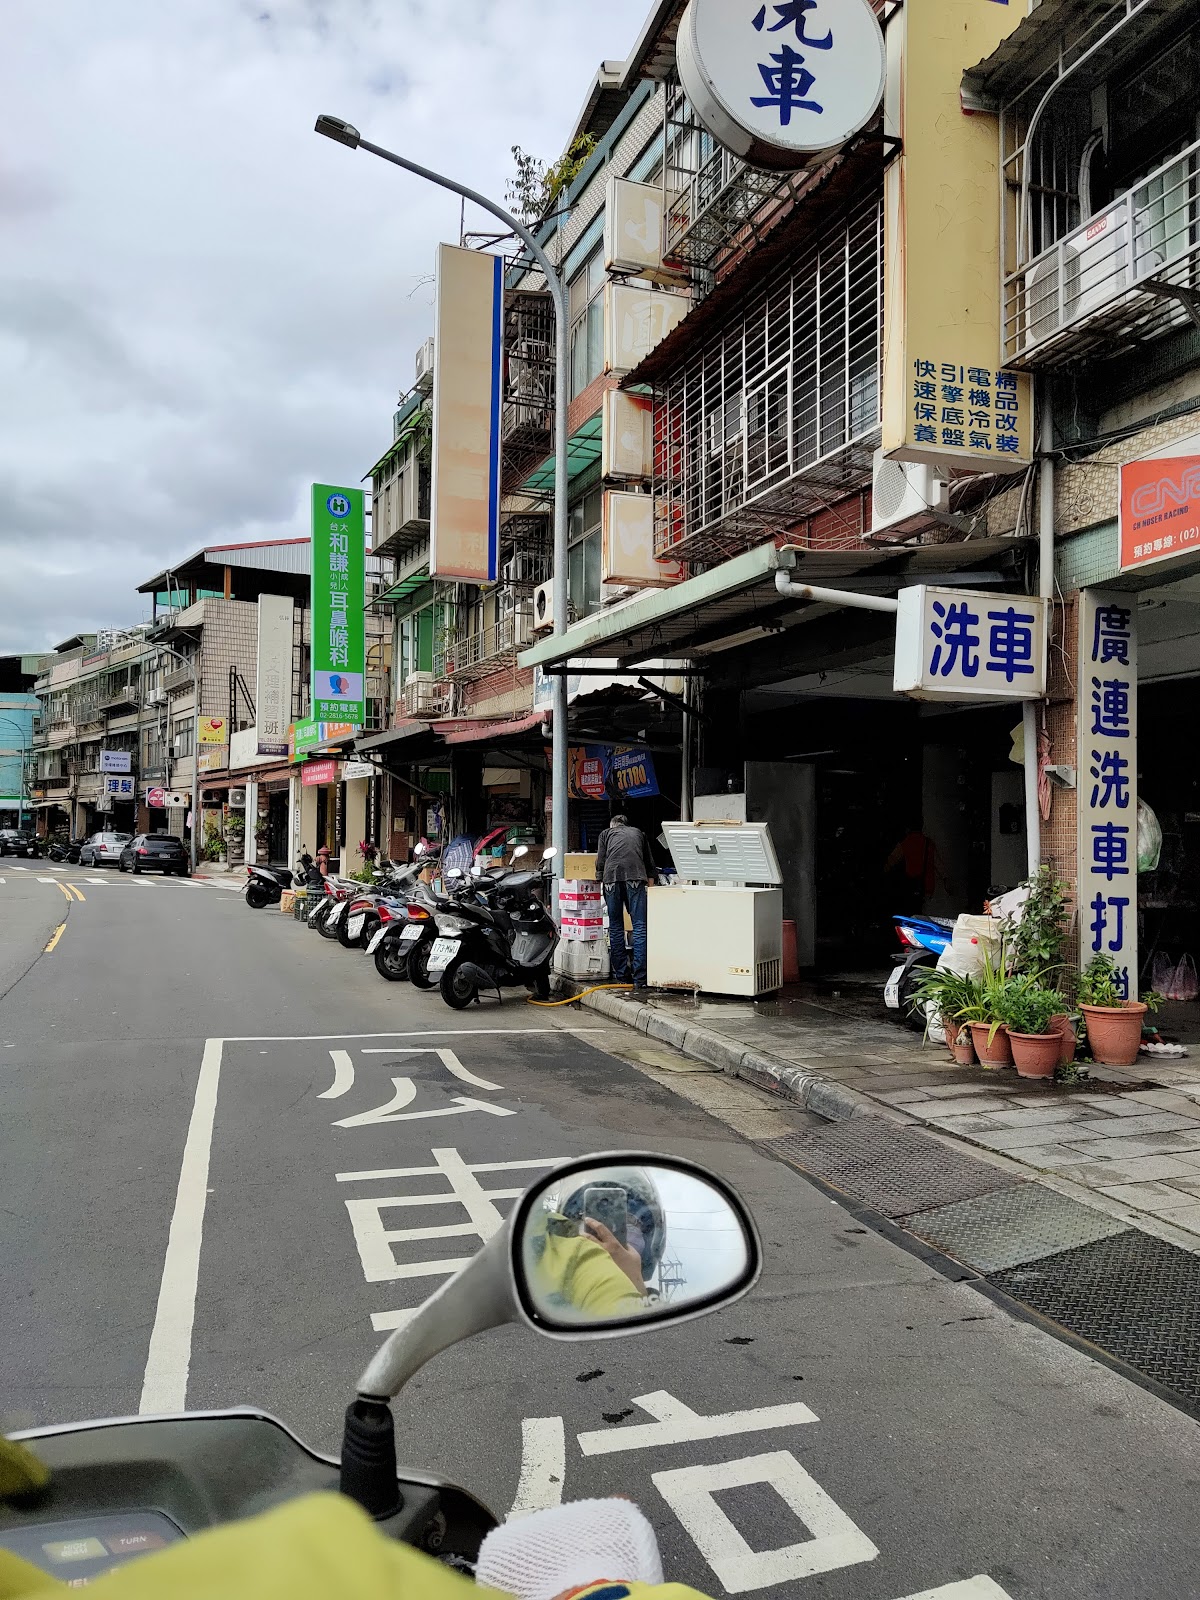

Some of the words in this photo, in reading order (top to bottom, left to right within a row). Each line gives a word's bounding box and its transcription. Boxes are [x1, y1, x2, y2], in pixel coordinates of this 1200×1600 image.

[914, 359, 937, 444] 快速保養
[941, 363, 965, 447] 引擎底盤
[967, 367, 991, 450] 電機冷氣
[995, 371, 1019, 454] 精品改裝
[329, 533, 349, 573] 和謙
[329, 591, 349, 667] 耳鼻喉科
[930, 601, 1035, 682] 洗車
[319, 712, 359, 720] 02-2816-5678
[320, 702, 358, 713] 預約電話
[108, 779, 132, 793] 理髮
[63, 1542, 87, 1551] HIGH
[119, 1535, 148, 1546] TURN
